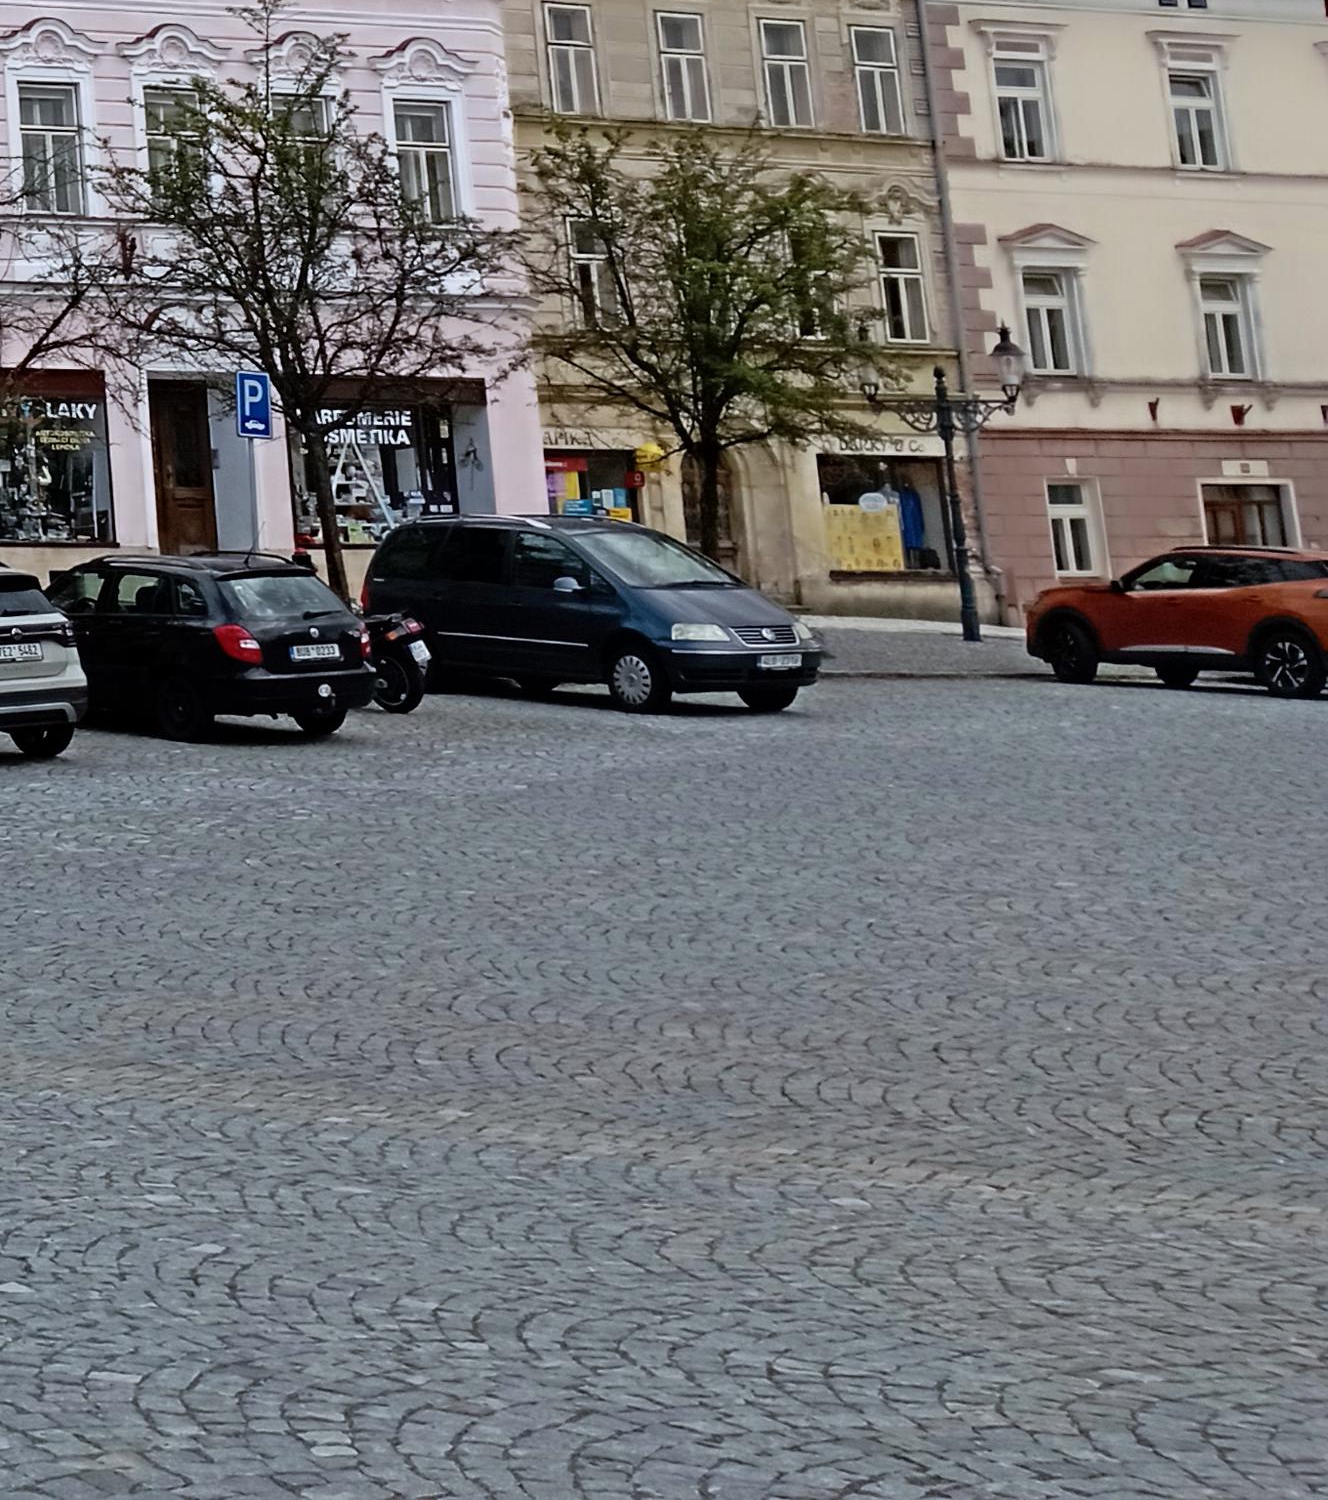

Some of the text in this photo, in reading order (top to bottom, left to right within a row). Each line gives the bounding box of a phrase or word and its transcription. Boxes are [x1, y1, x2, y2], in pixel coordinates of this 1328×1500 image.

[243, 379, 264, 416] P
[46, 402, 97, 420] LAKY
[301, 428, 411, 446] SMETIKA
